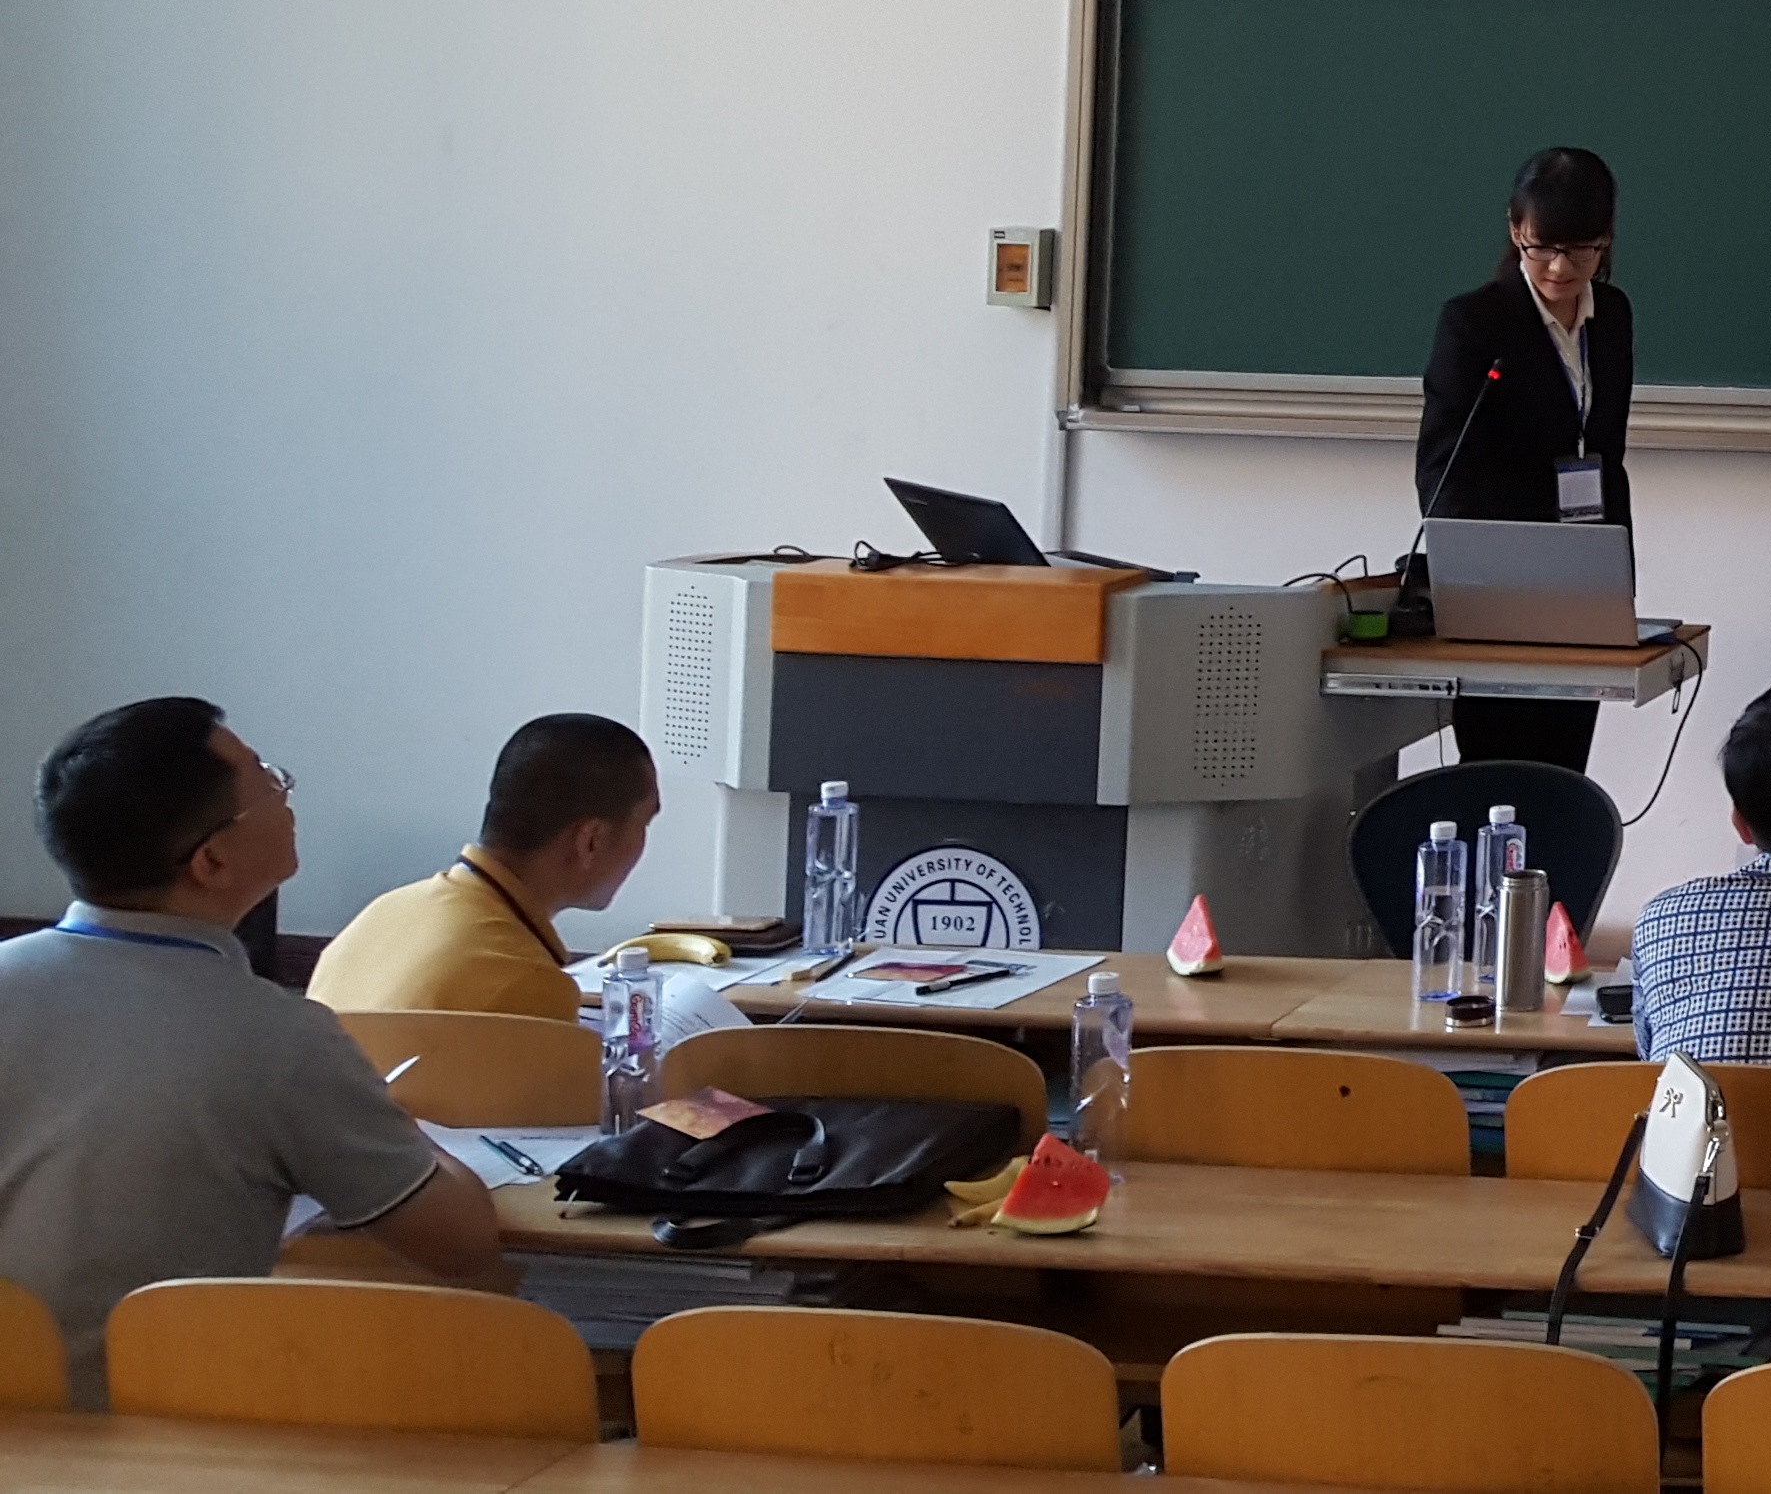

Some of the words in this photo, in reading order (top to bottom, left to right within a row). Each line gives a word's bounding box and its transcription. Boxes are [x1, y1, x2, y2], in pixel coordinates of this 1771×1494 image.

[873, 906, 891, 939] UAN
[884, 857, 974, 903] UNIVERSITY
[975, 863, 997, 881] OF
[998, 875, 1032, 945] TECHNOL
[931, 915, 976, 932] 1902
